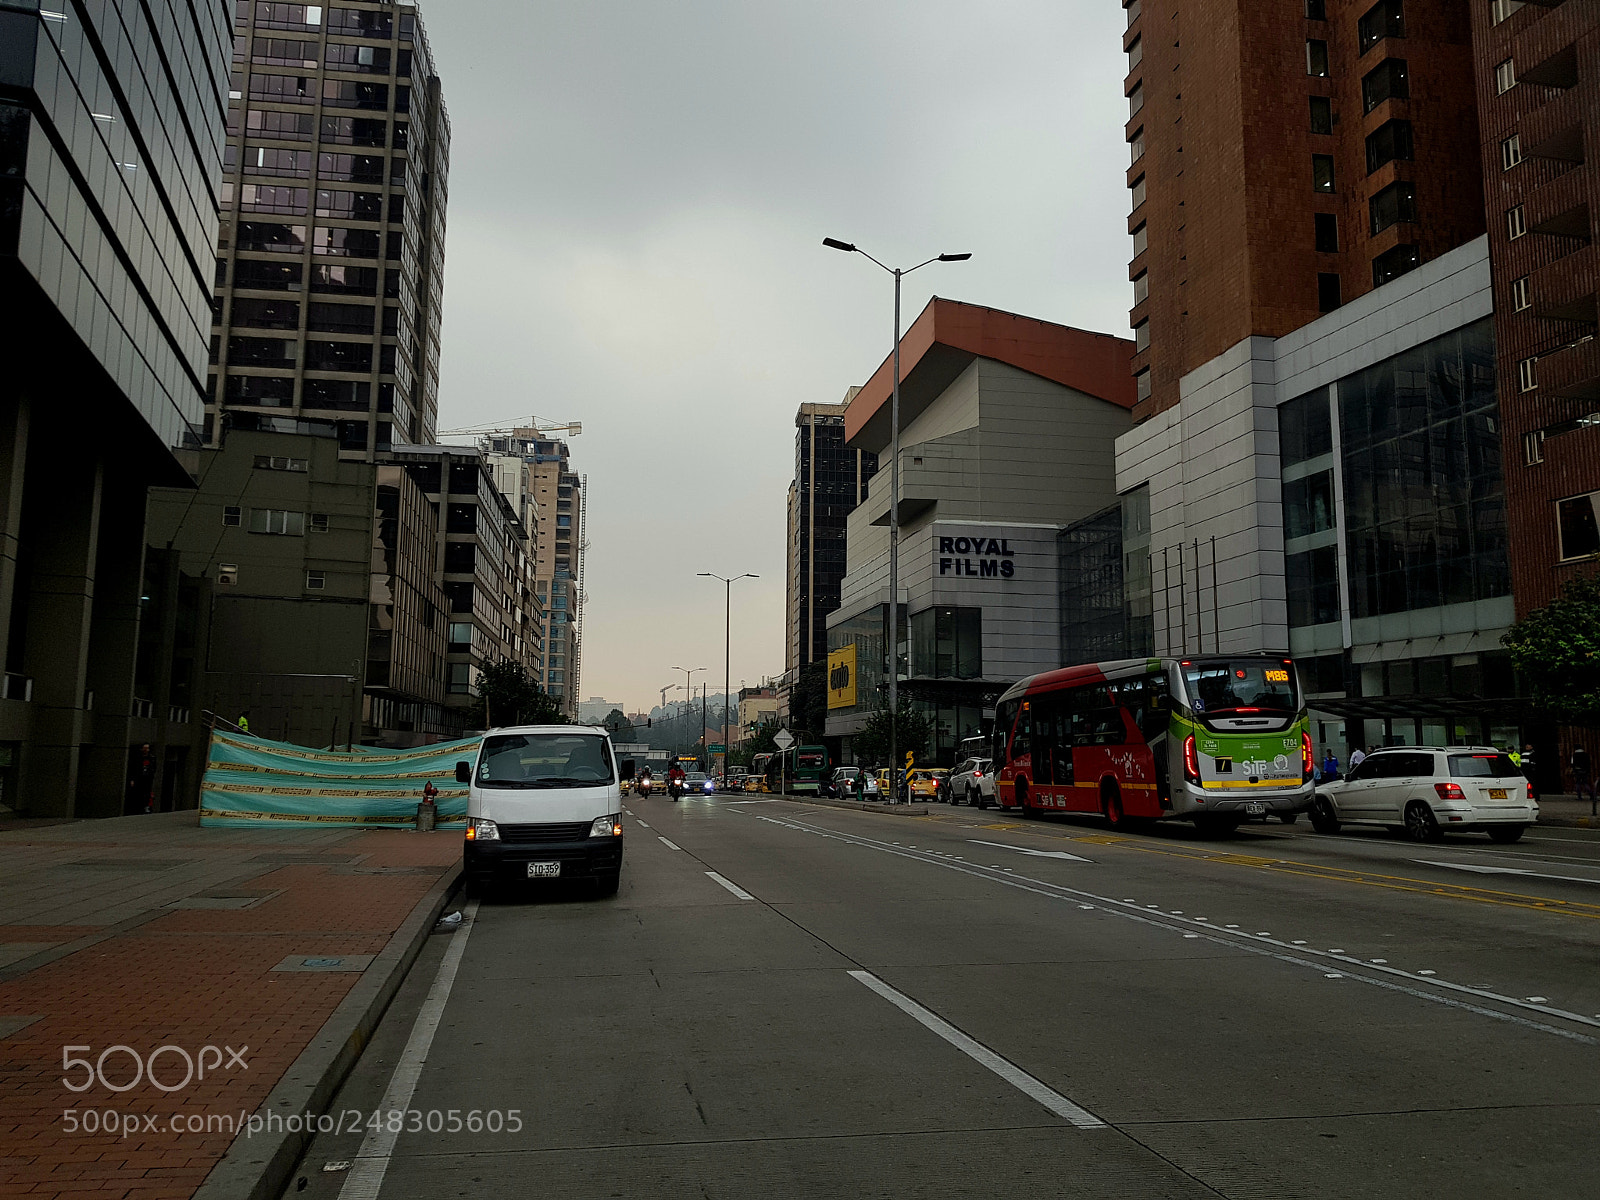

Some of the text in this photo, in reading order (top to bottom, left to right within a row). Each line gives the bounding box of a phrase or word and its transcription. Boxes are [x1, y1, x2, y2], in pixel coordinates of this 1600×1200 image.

[940, 536, 1014, 556] ROYAL
[940, 558, 1014, 577] FILMS
[1265, 670, 1289, 682] M86
